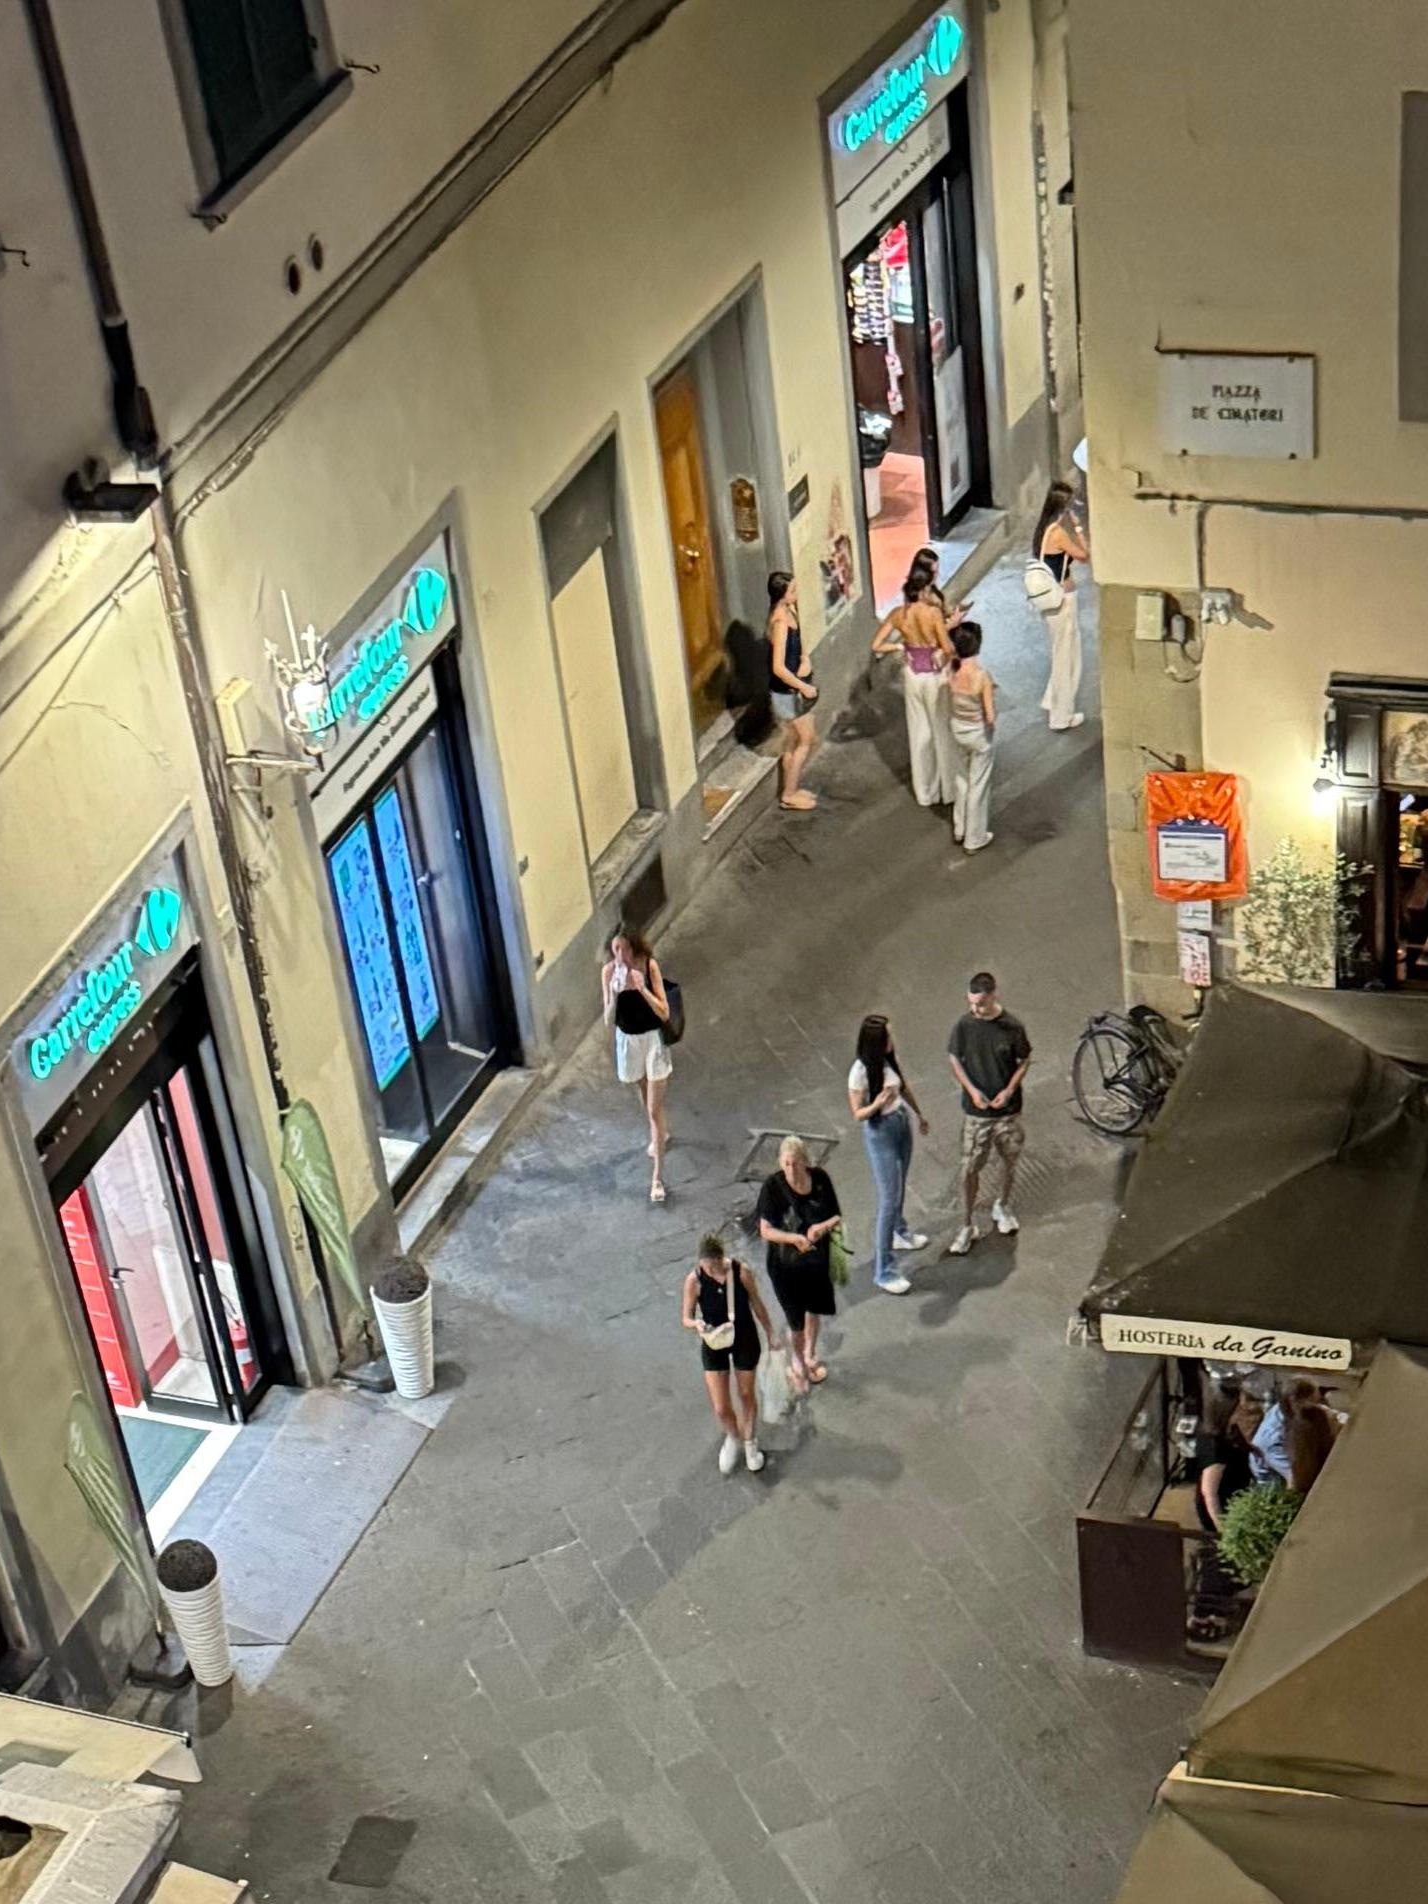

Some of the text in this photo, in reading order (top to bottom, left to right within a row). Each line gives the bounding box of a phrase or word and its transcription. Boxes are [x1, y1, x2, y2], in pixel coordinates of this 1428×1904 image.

[843, 54, 925, 151] Carrefour
[1212, 384, 1261, 402] PIAZZA
[28, 940, 135, 1081] Carrefour
[87, 978, 142, 1055] express
[1118, 1327, 1344, 1361] HOSTERIA da Ganino
